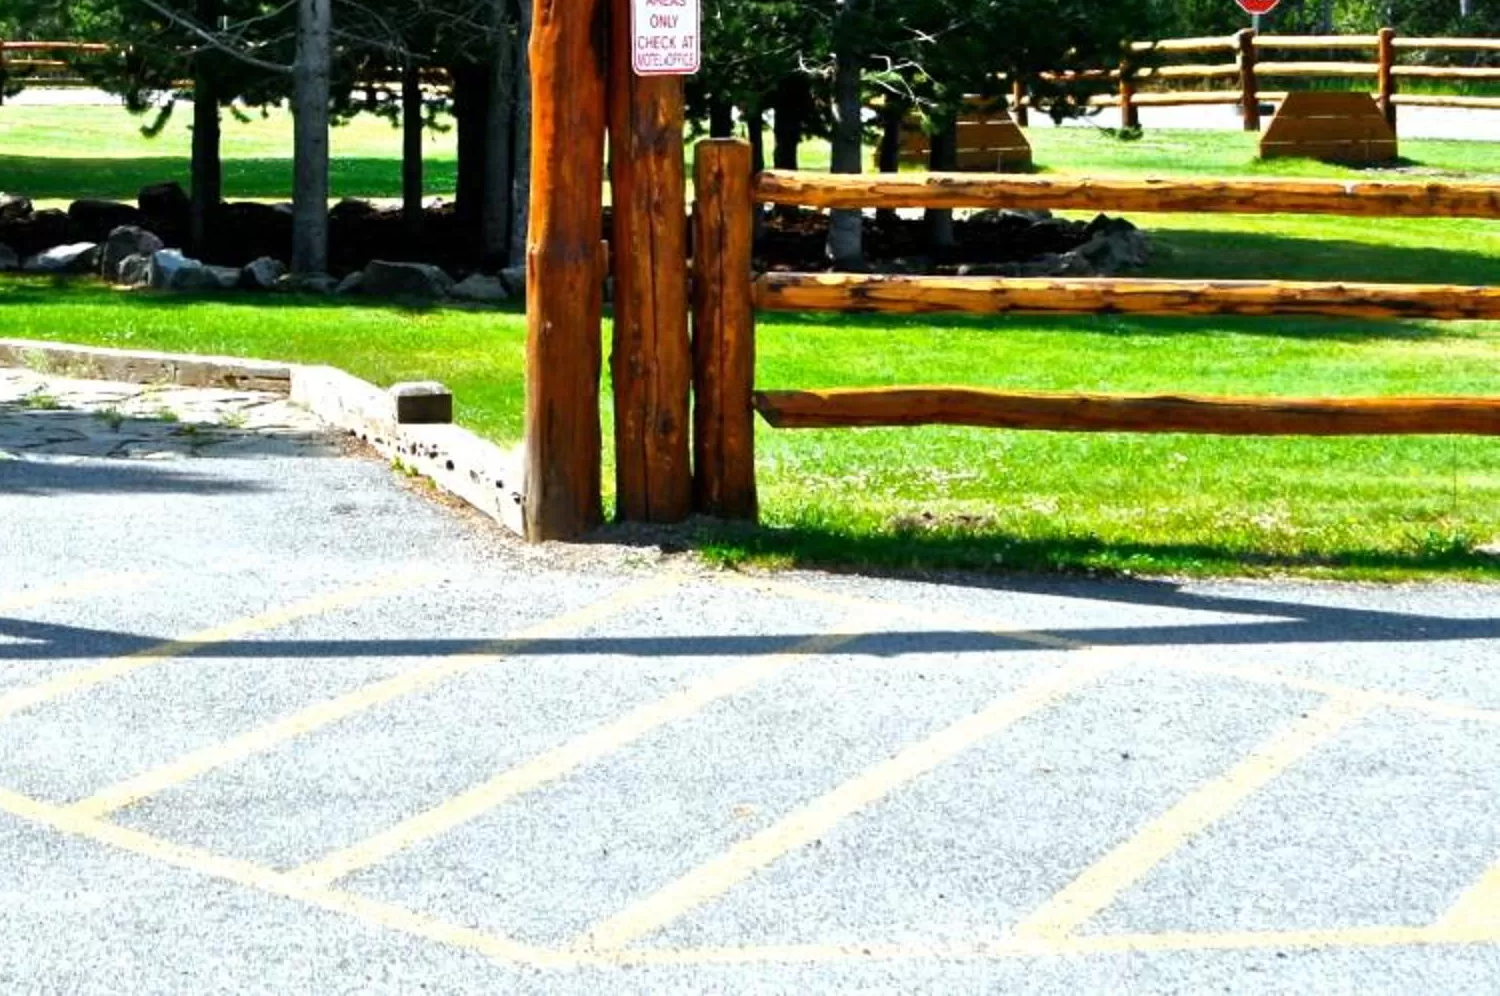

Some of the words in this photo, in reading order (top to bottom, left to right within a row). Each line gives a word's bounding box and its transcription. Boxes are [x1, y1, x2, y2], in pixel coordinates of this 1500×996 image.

[649, 13, 679, 29] ONLY
[637, 35, 677, 50] CHECK
[681, 35, 694, 49] AT
